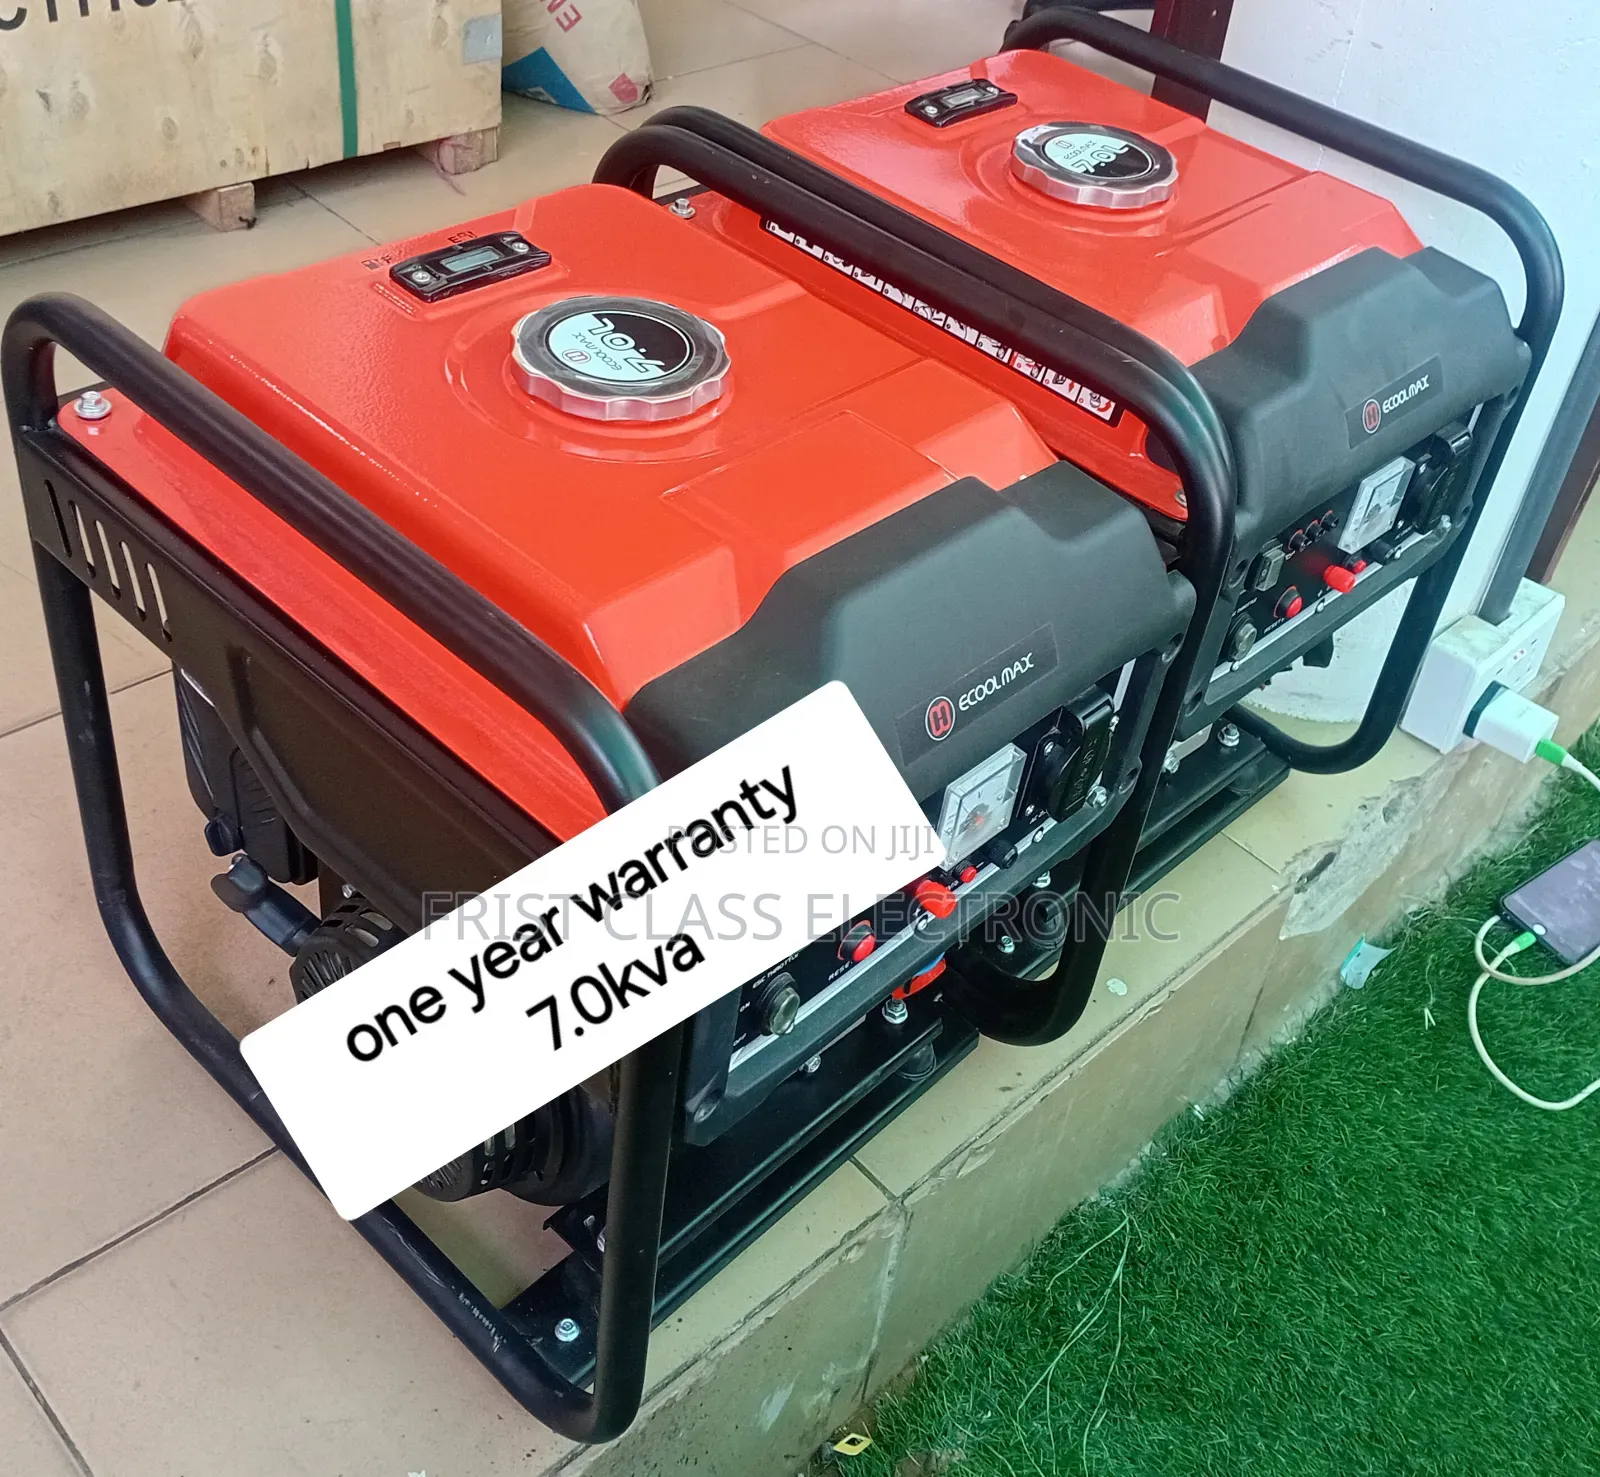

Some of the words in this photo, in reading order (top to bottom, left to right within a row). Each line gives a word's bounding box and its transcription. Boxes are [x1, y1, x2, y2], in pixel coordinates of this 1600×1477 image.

[1071, 144, 1129, 173] 7.0L
[588, 317, 665, 374] 7.0L
[1382, 374, 1430, 414] ECOOLMAX
[958, 652, 1034, 711] ECOOLMAX
